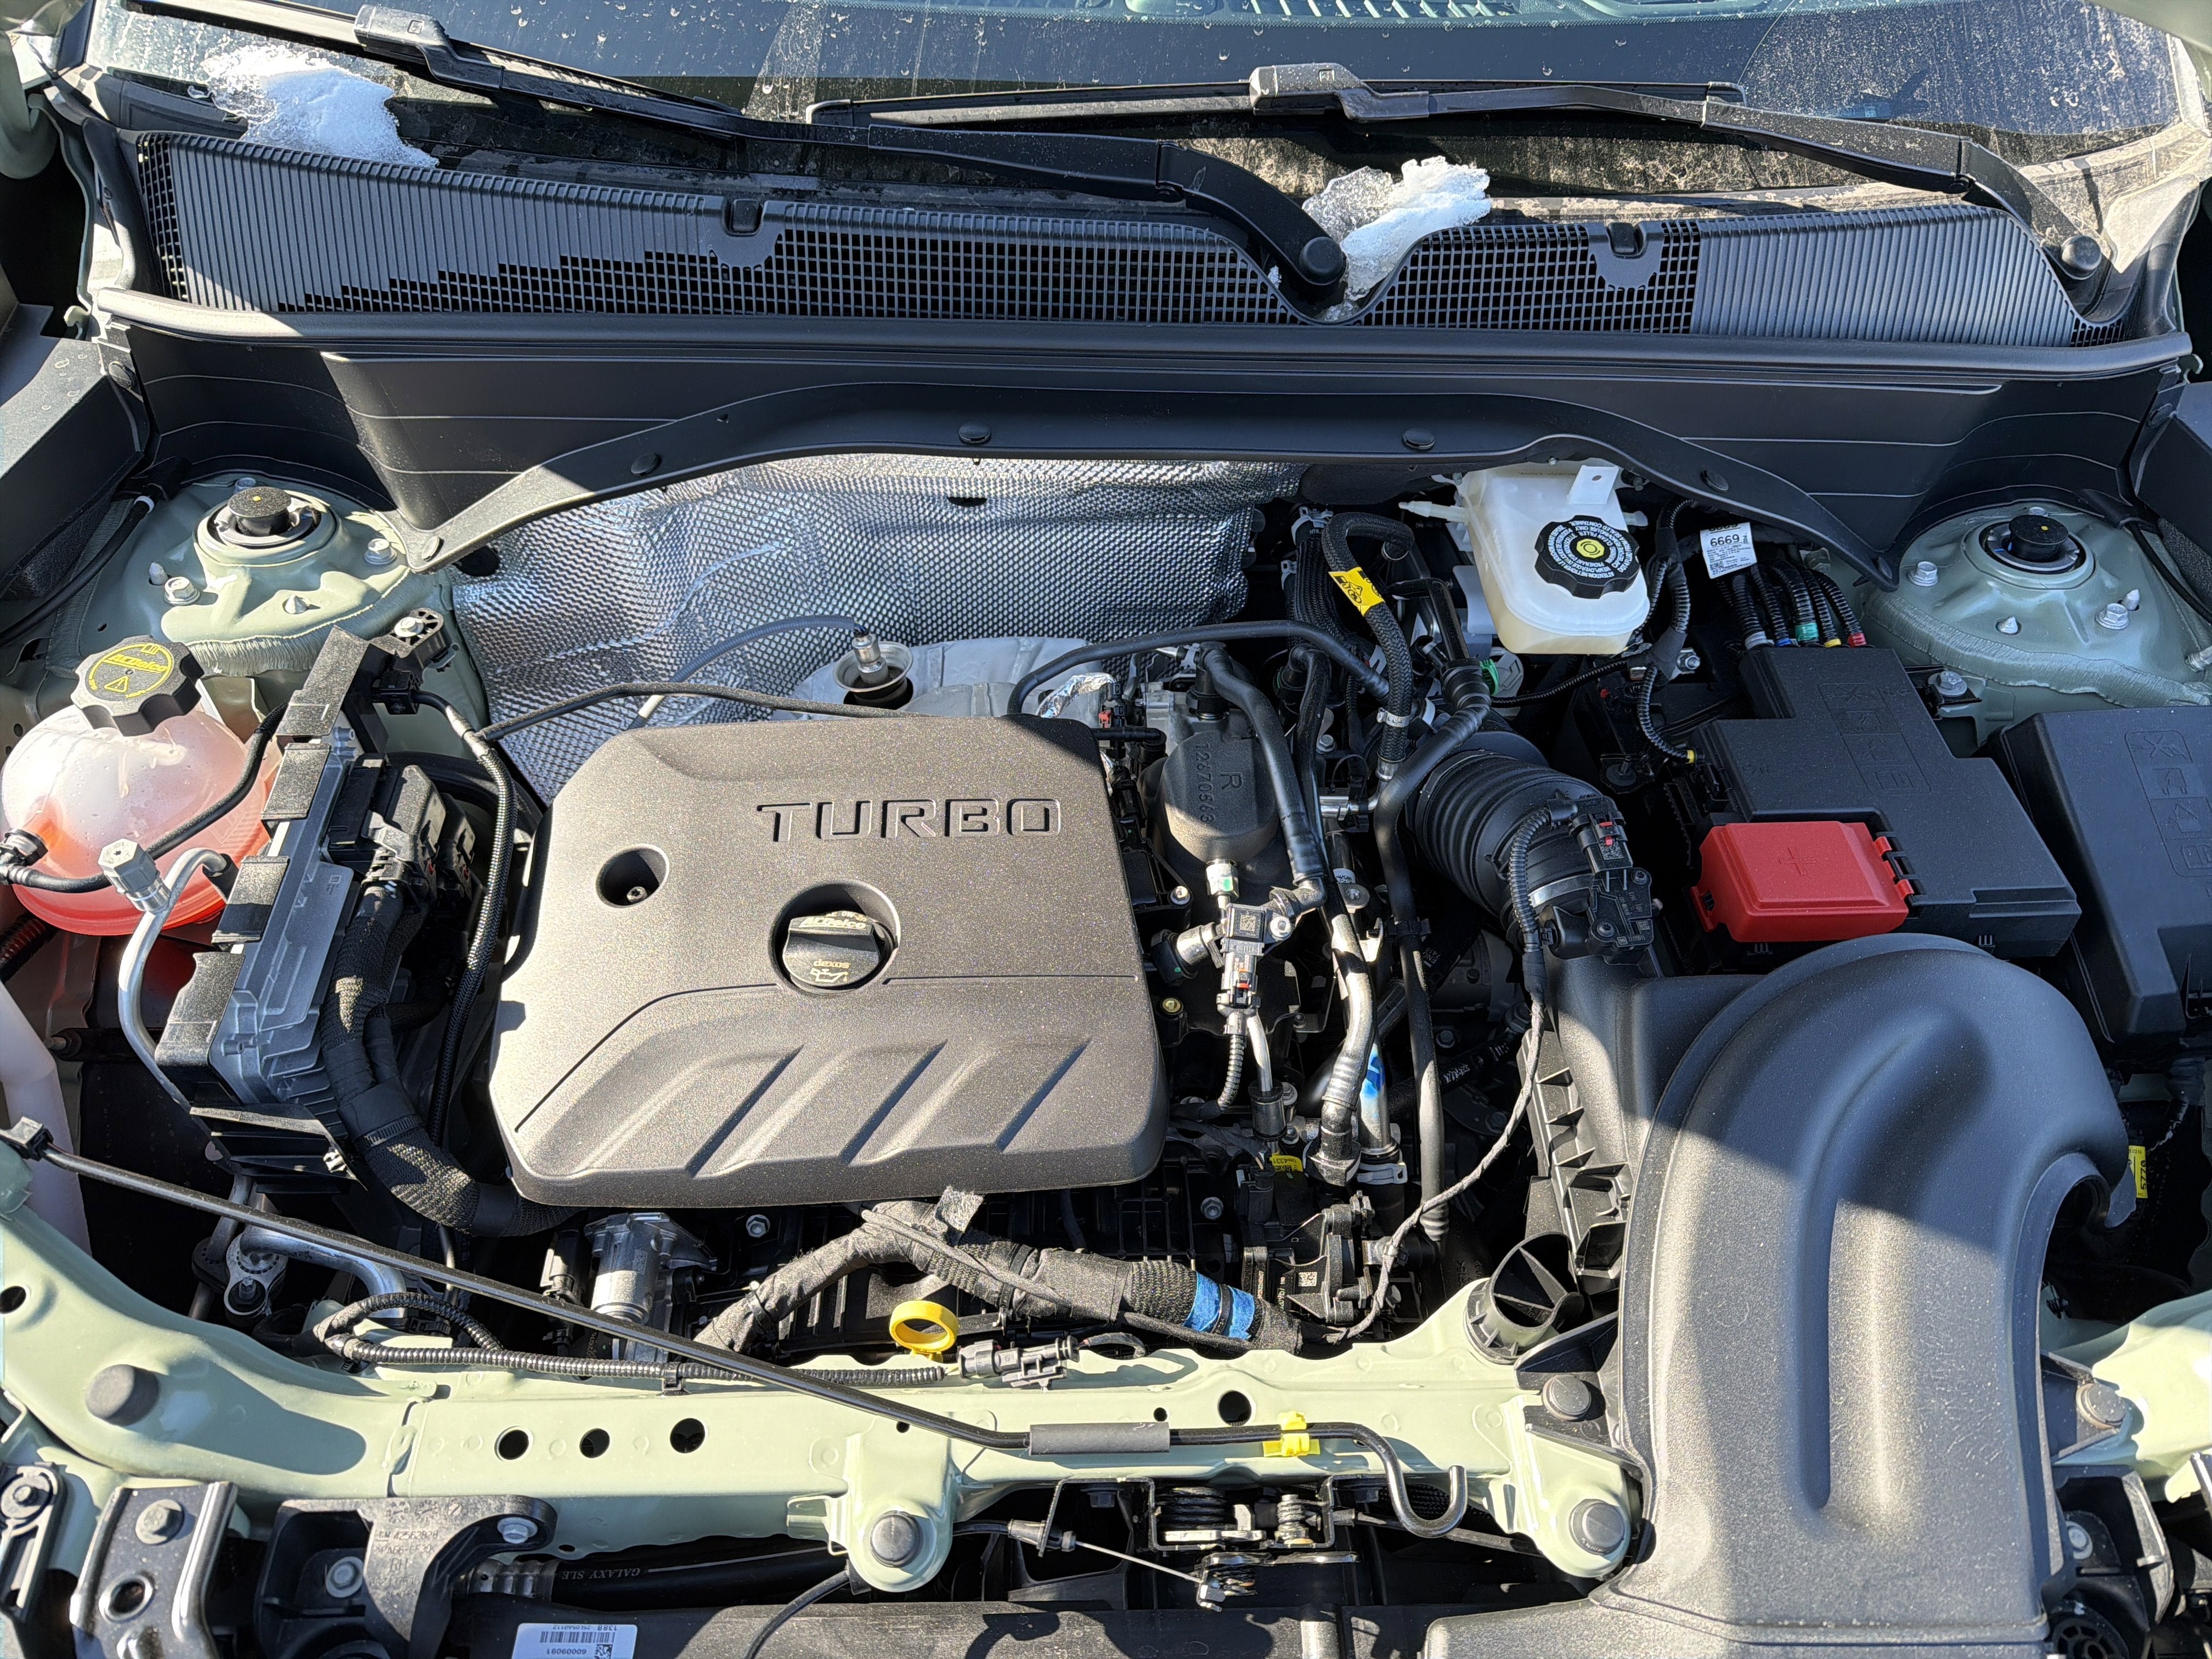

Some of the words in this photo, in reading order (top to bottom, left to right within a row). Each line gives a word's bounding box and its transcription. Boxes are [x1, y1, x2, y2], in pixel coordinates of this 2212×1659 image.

[1602, 526, 1622, 538] SEALED
[1598, 533, 1613, 546] CLEAN
[1621, 540, 1632, 551] FROM
[1710, 534, 1740, 546] 6669
[1548, 546, 1561, 562] BOUCHON
[1624, 552, 1633, 563] FLUID
[1576, 559, 1605, 567] PROVENANT
[1617, 564, 1628, 572] DOT
[1564, 564, 1587, 576] NETTOYER
[108, 653, 167, 673] ACDelco
[1195, 742, 1216, 823] 12670563
[1220, 772, 1244, 791] R
[757, 798, 1062, 843] TURBO
[798, 917, 867, 929] ACDelco
[813, 958, 851, 969] dexos
[390, 1557, 409, 1573] RH
[562, 1570, 585, 1579] SLE
[588, 1567, 641, 1579] GALAXY
